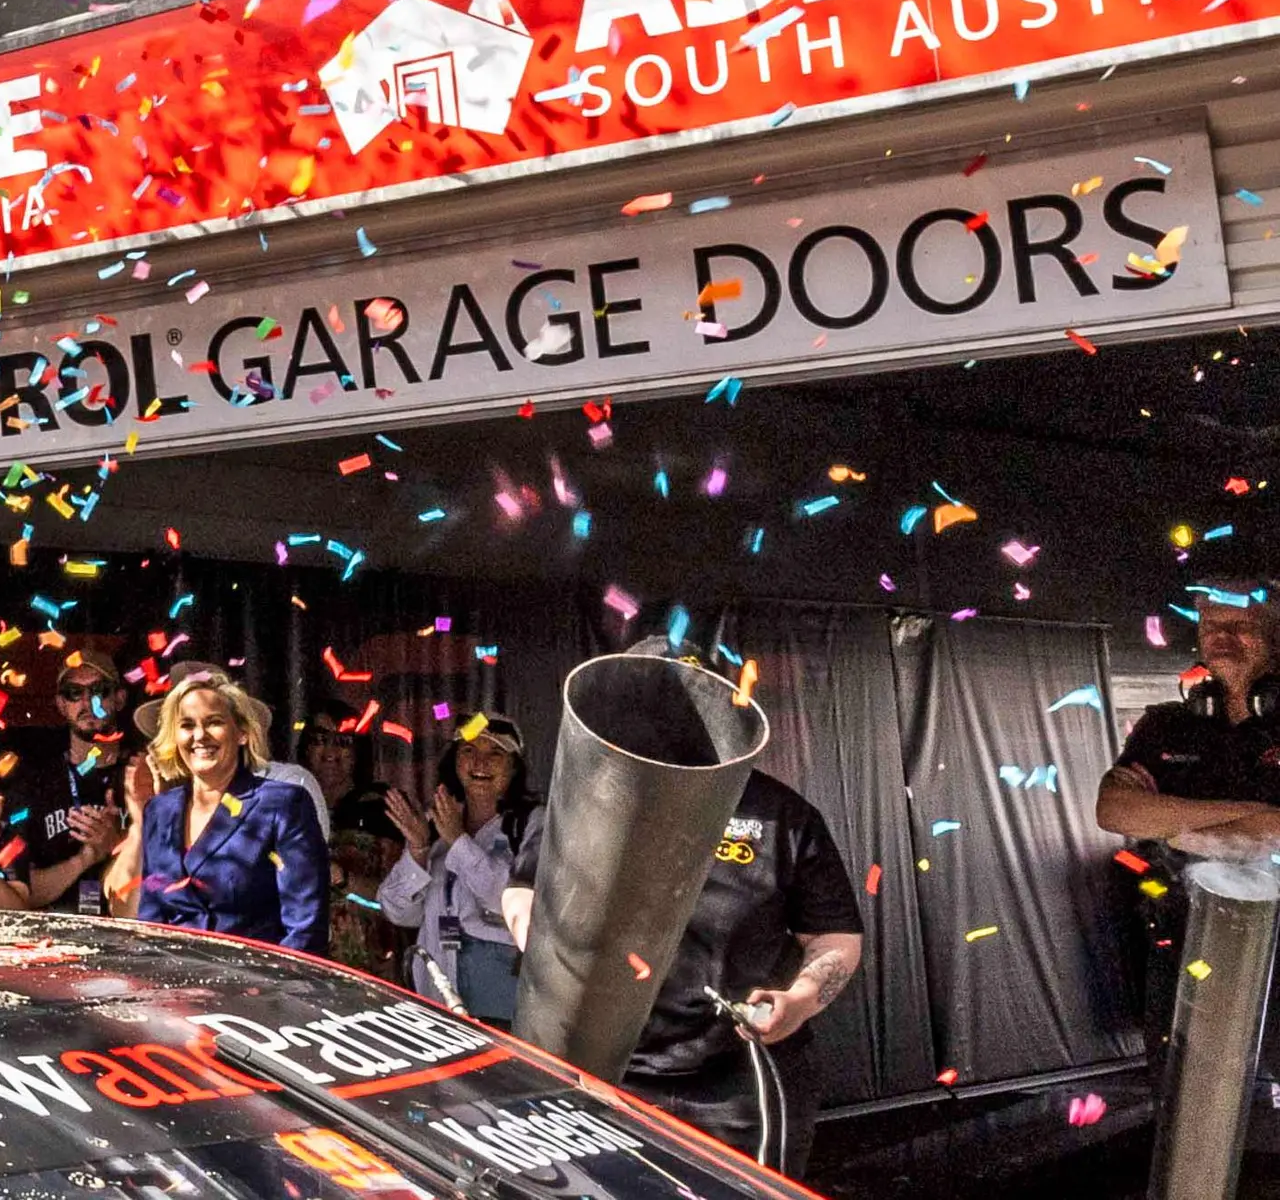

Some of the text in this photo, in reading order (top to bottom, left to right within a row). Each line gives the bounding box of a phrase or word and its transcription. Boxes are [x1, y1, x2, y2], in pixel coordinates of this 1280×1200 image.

[579, 13, 847, 119] SOUTH
[207, 256, 652, 407] GARAGE
[692, 176, 1182, 345] DOORS
